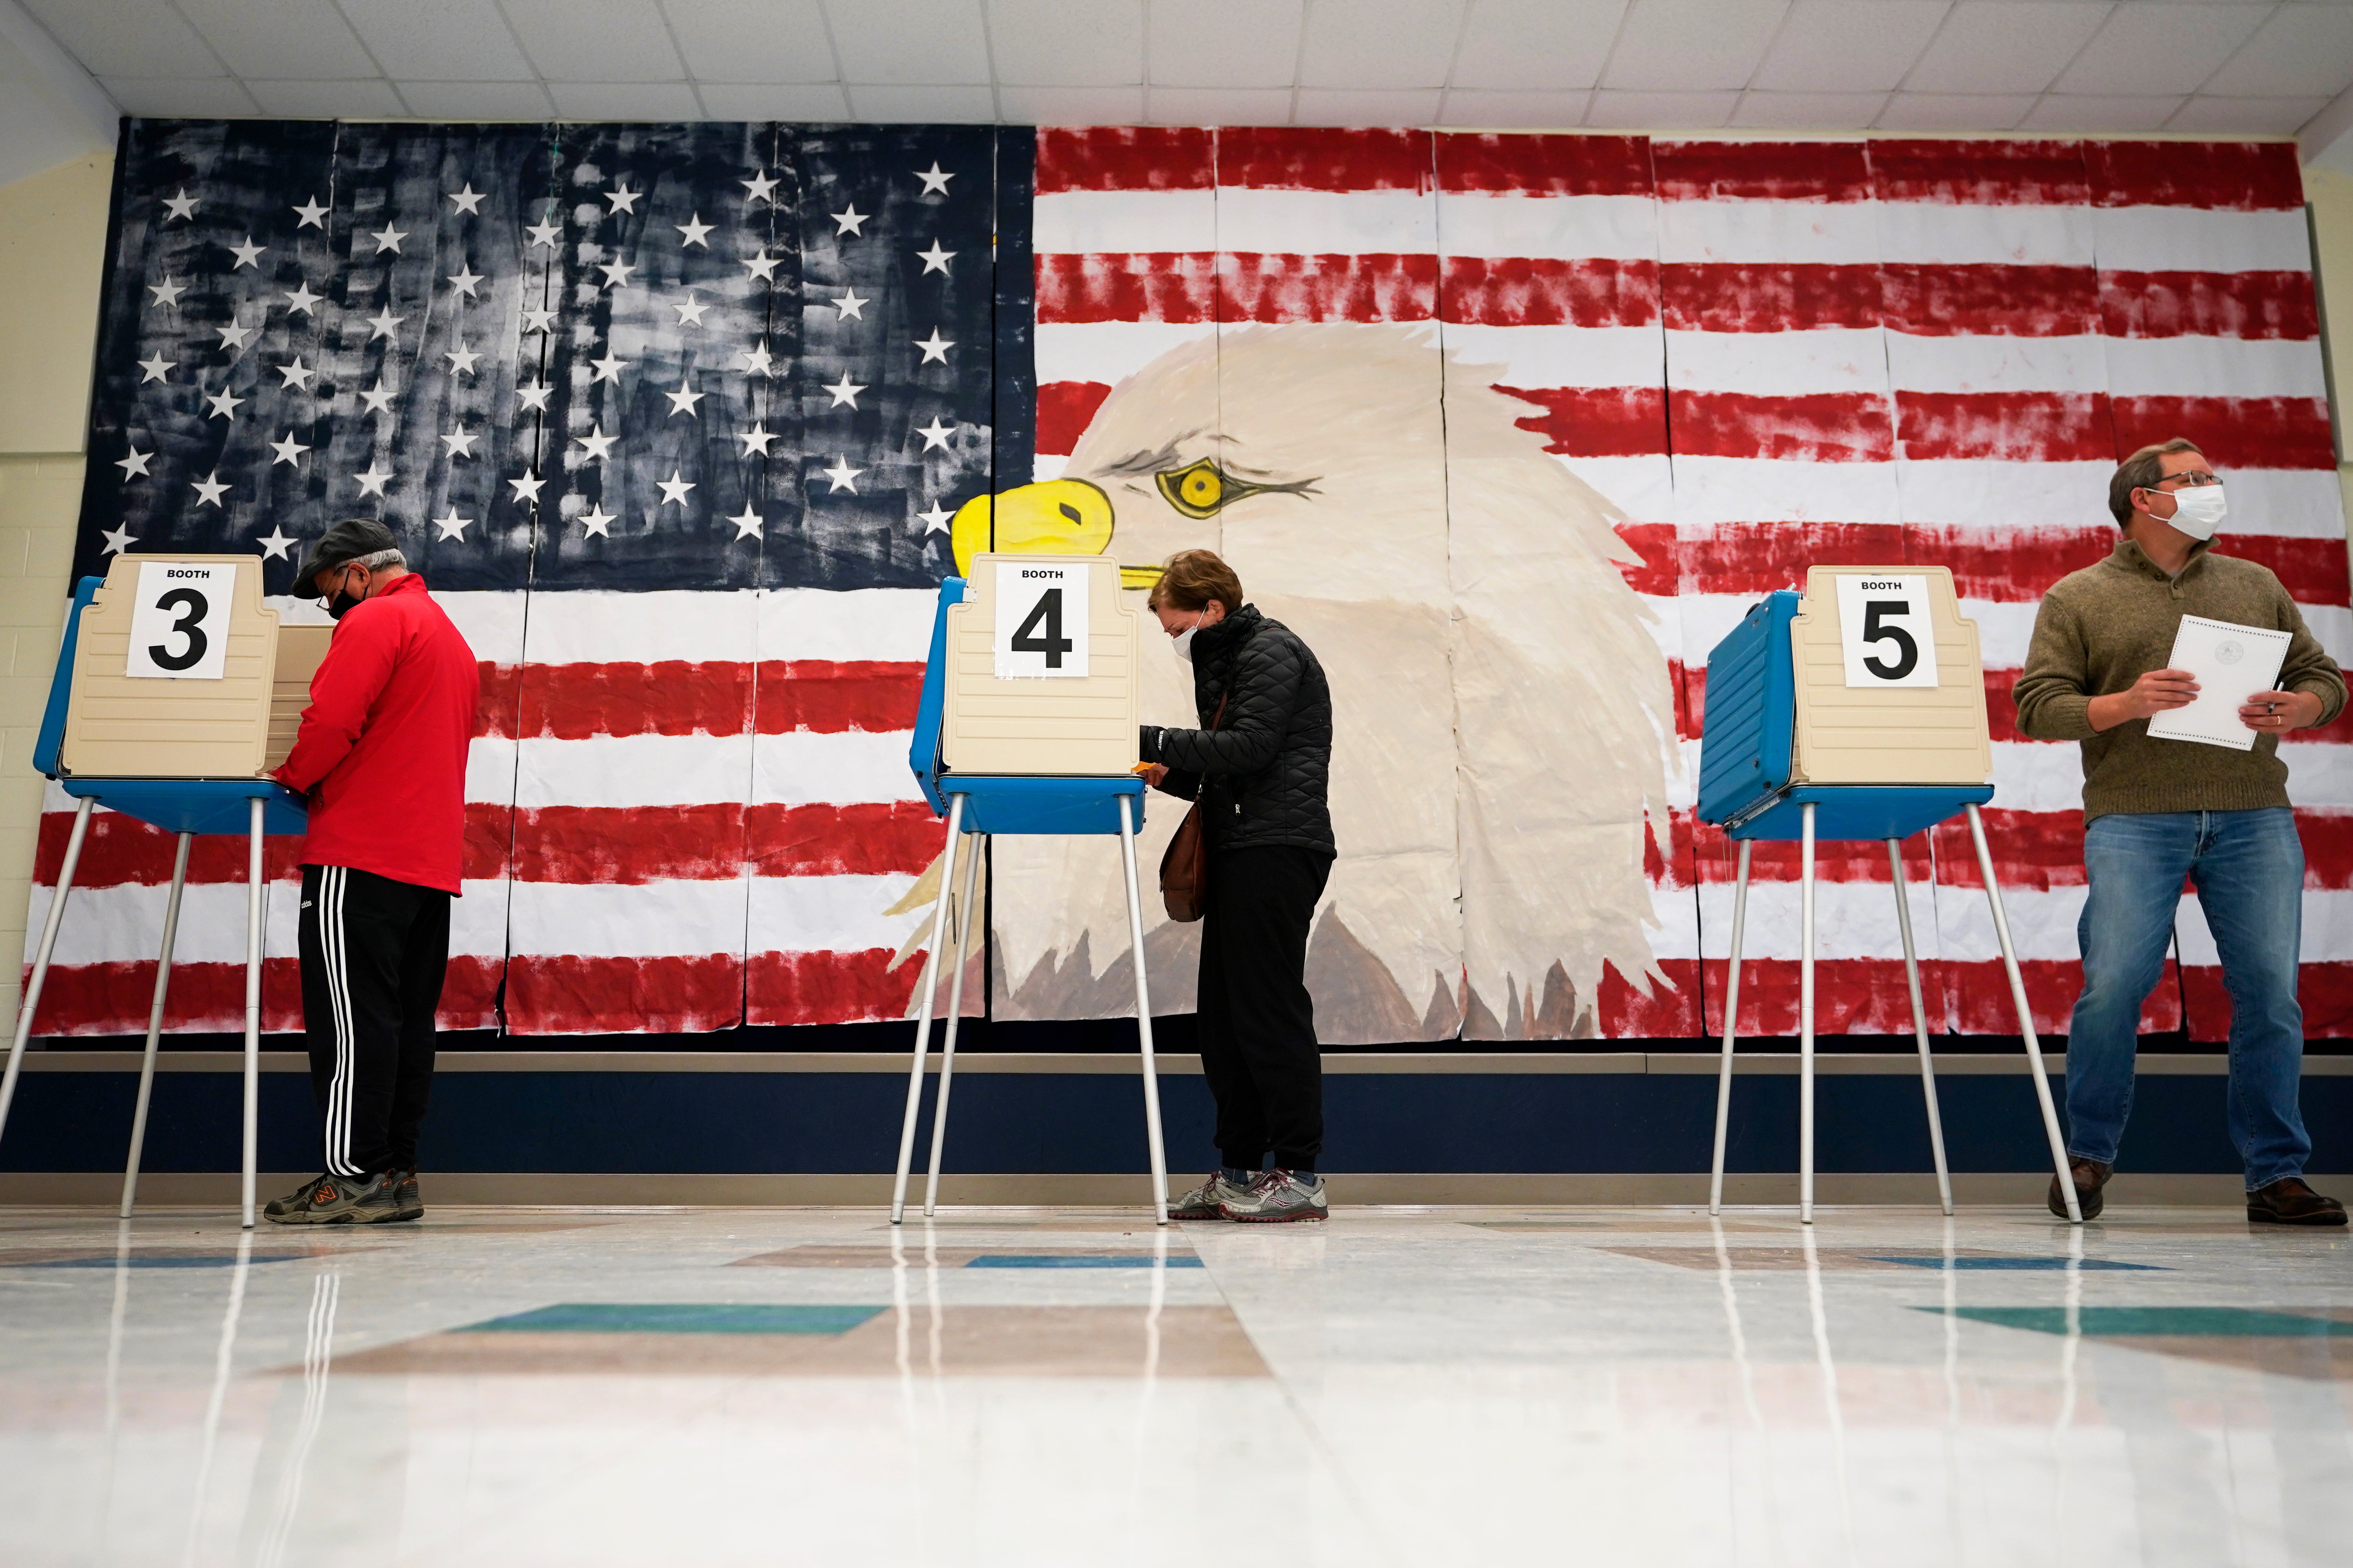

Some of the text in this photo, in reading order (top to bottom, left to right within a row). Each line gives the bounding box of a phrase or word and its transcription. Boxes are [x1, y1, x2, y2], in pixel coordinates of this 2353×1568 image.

[167, 570, 210, 579] BOOTH
[1022, 570, 1063, 578] BOOTH
[1861, 582, 1902, 590] BOOTH
[148, 588, 208, 671] 3
[1011, 589, 1072, 668] 4
[1863, 601, 1918, 680] 5
[301, 899, 312, 909] adidas
